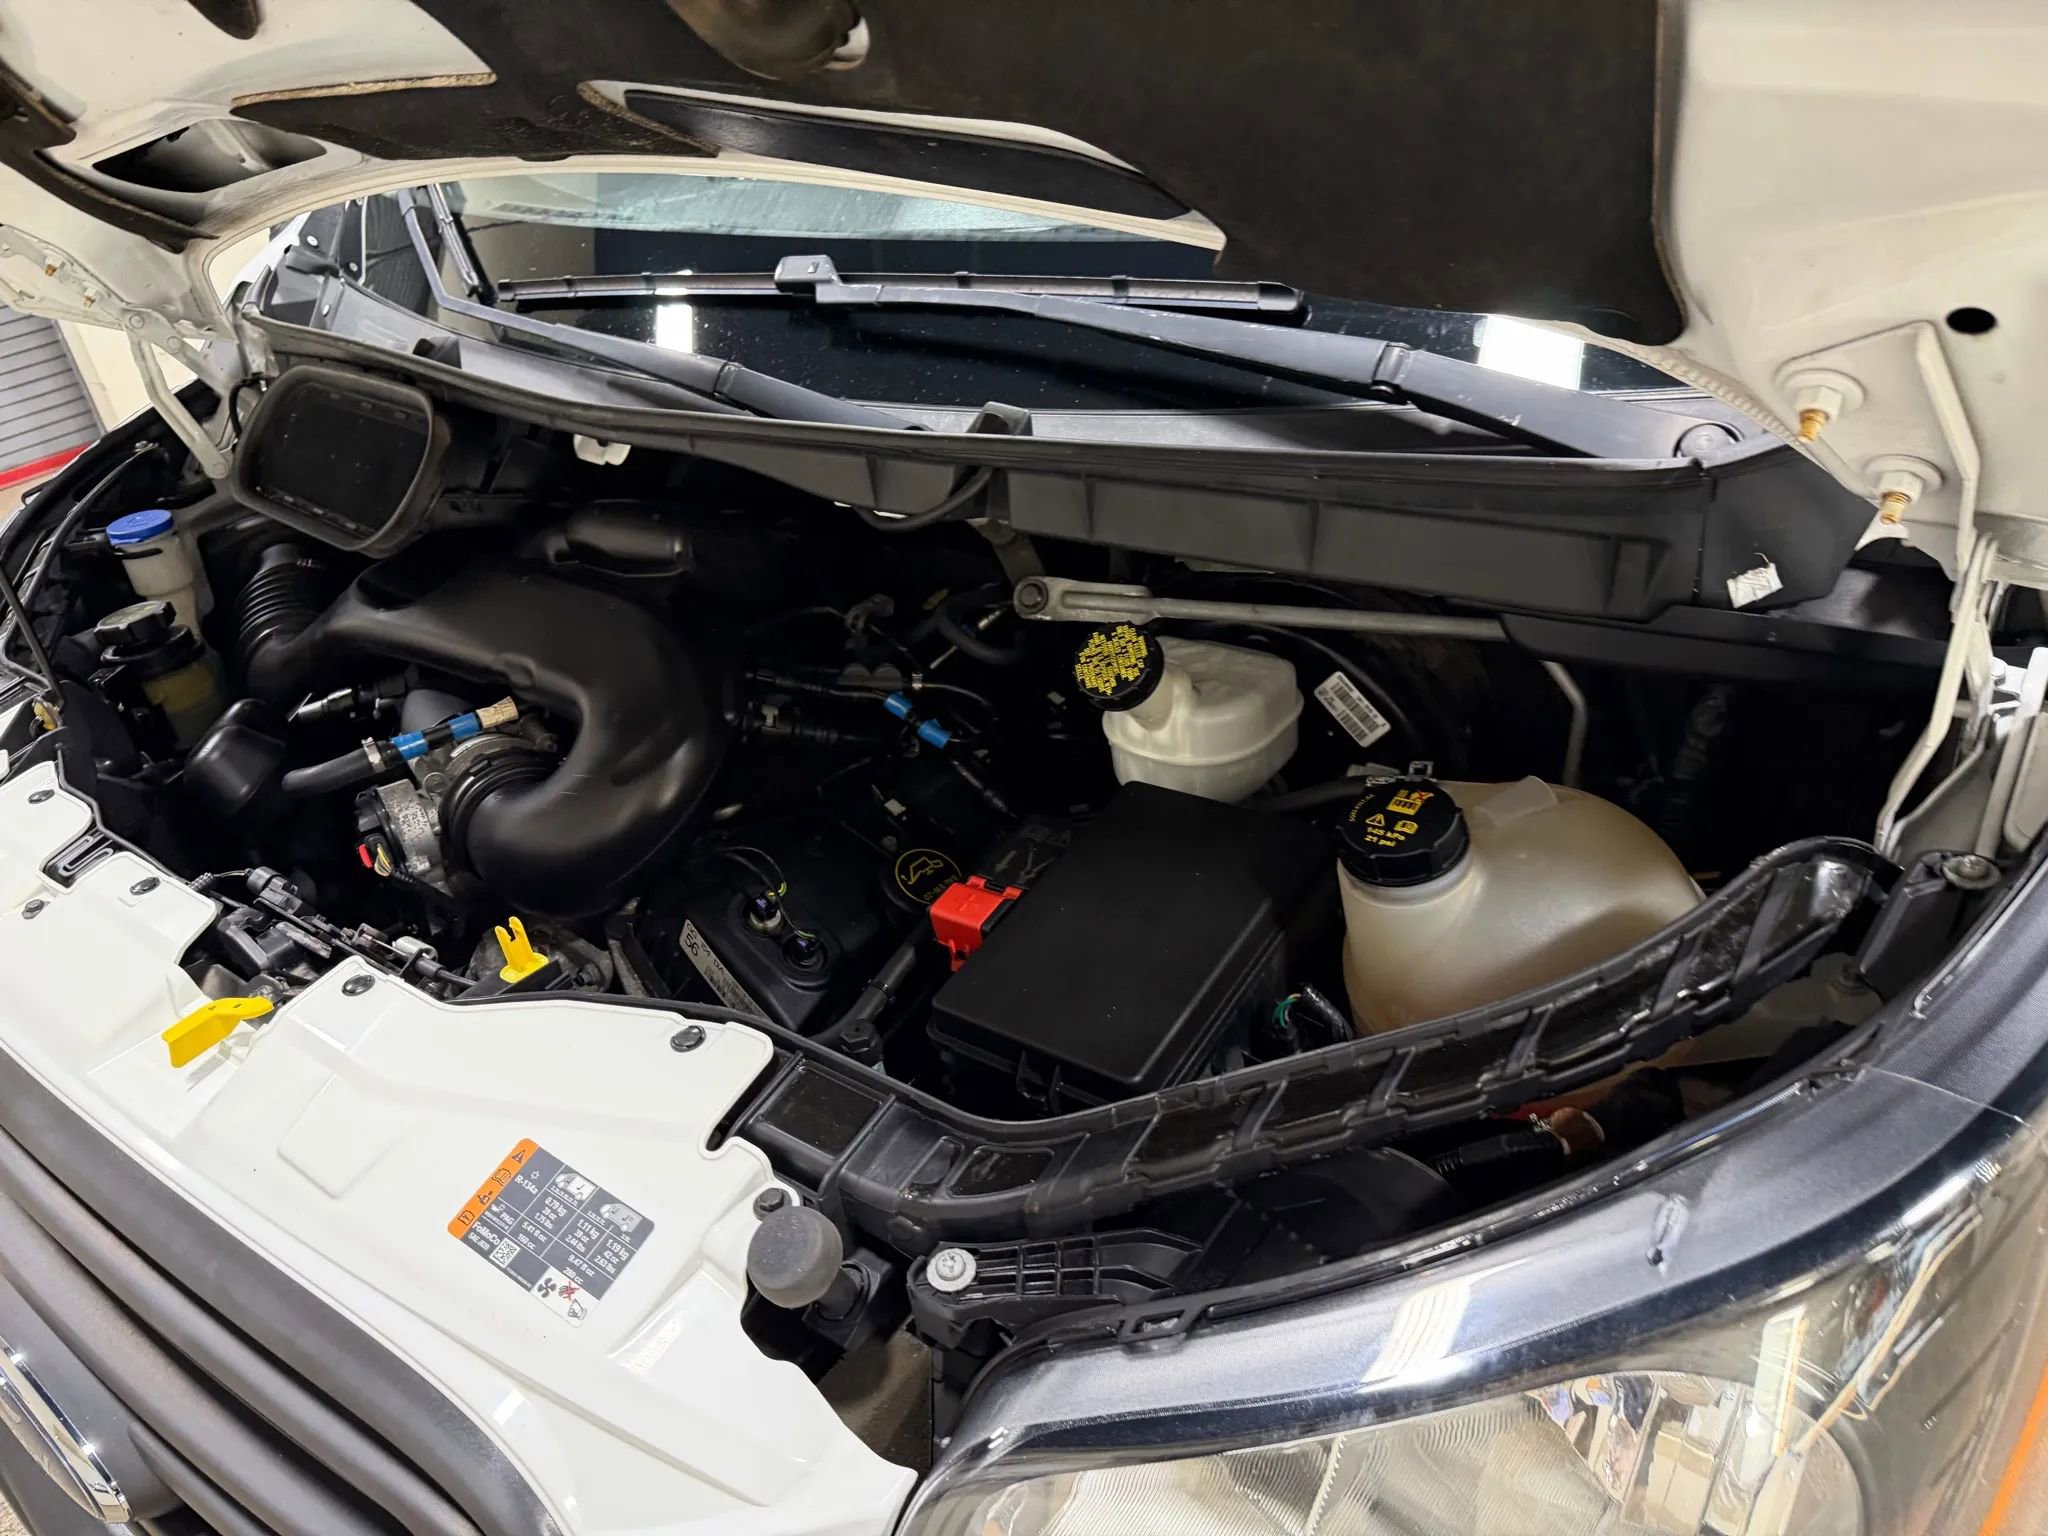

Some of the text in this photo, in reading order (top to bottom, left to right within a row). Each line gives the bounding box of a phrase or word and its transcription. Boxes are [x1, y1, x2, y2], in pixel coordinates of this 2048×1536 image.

[685, 932, 700, 957] 56
[514, 1174, 539, 1194] R-134a
[544, 1196, 568, 1217] 0.79 kg
[499, 1211, 515, 1225] PAG
[533, 1211, 555, 1229] 1.75 lbs
[548, 1212, 557, 1220] oz
[467, 1231, 481, 1243] SAE
[471, 1220, 502, 1245] FoMoCo
[520, 1220, 535, 1233] 5.41
[537, 1233, 547, 1242] oz
[575, 1218, 601, 1240] 1.11 kg
[526, 1241, 536, 1250] cc
[564, 1234, 587, 1252] 2.44 lbs
[580, 1234, 589, 1243] oz
[602, 1249, 619, 1264] 42 oz
[604, 1238, 631, 1261] 1.19 kg
[566, 1253, 583, 1267] 9.47
[584, 1268, 595, 1277] oz
[593, 1254, 617, 1273] 2.63 lbs
[573, 1275, 584, 1285] cc
